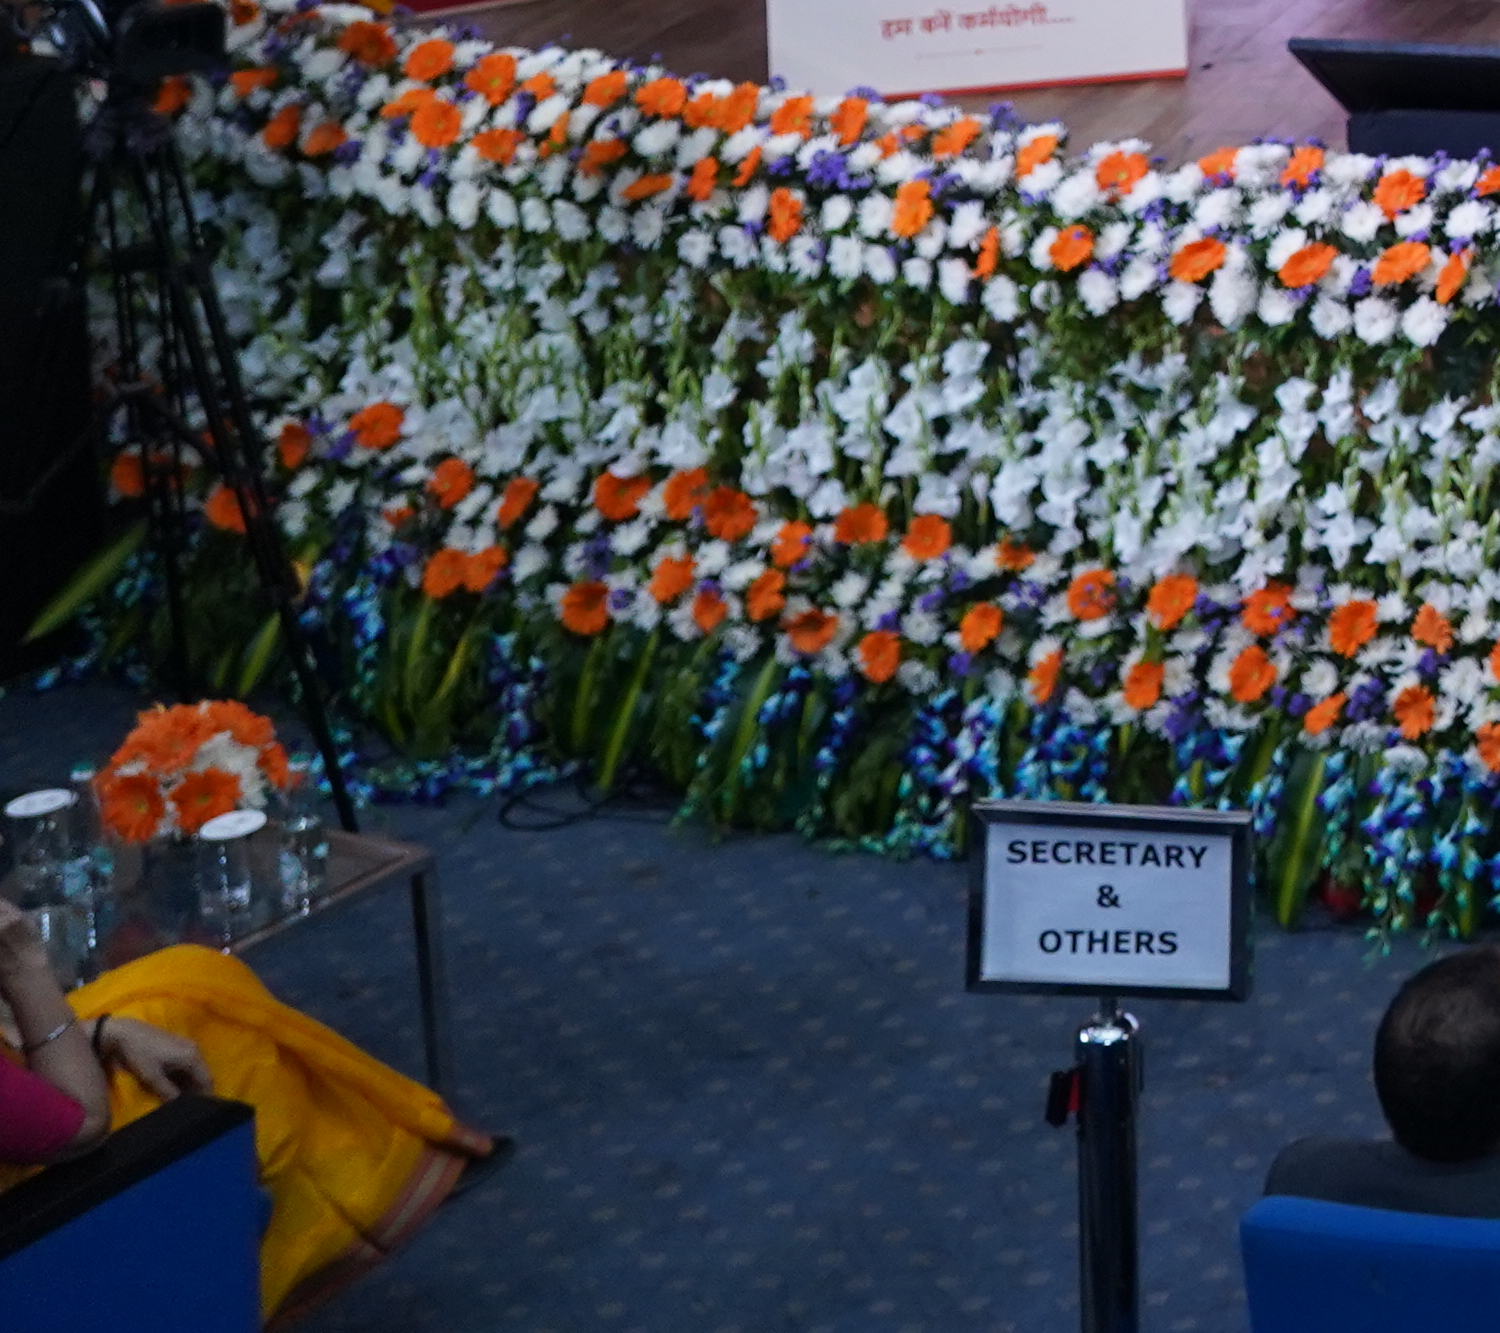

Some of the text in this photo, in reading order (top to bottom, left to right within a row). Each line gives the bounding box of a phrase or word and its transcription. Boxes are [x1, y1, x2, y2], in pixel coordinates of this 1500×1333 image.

[1006, 838, 1209, 869] SECRETARY
[1096, 884, 1121, 909] &
[1038, 928, 1179, 956] OTHERS
